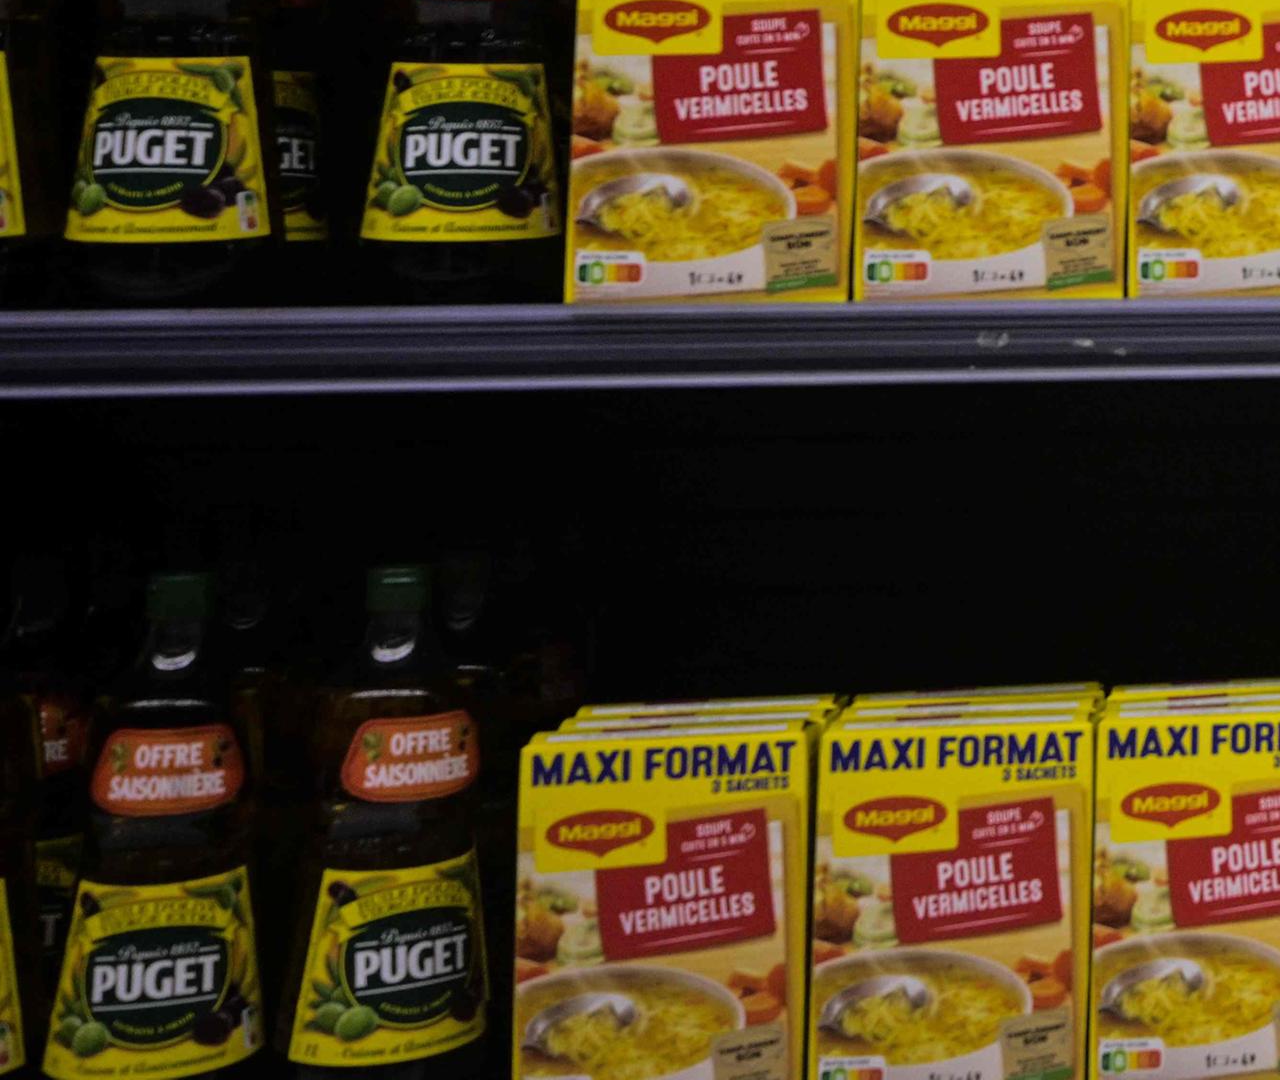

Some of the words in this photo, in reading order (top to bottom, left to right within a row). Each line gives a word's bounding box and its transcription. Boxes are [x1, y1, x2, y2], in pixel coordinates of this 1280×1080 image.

[700, 61, 778, 92] POULE
[980, 63, 1055, 93] POULE
[674, 88, 808, 121] VERMICELLES
[956, 89, 1083, 121] VERMICELLES
[92, 128, 214, 167] PUGET
[404, 131, 522, 168] PUGET
[134, 743, 204, 768] OFFRE
[389, 728, 452, 753] OFFRE
[831, 739, 924, 772] MAXI
[939, 732, 1082, 768] FORMAT
[1108, 727, 1197, 759] MAXI
[532, 751, 630, 787] MAXI
[644, 741, 796, 780] FORMAT
[644, 866, 724, 905] POULE
[937, 853, 1013, 890] POULE
[619, 893, 755, 936] VERMICELLES
[912, 880, 1043, 920] VERMICELLES
[90, 954, 221, 1005] PUGET
[353, 933, 468, 989] PUGET
